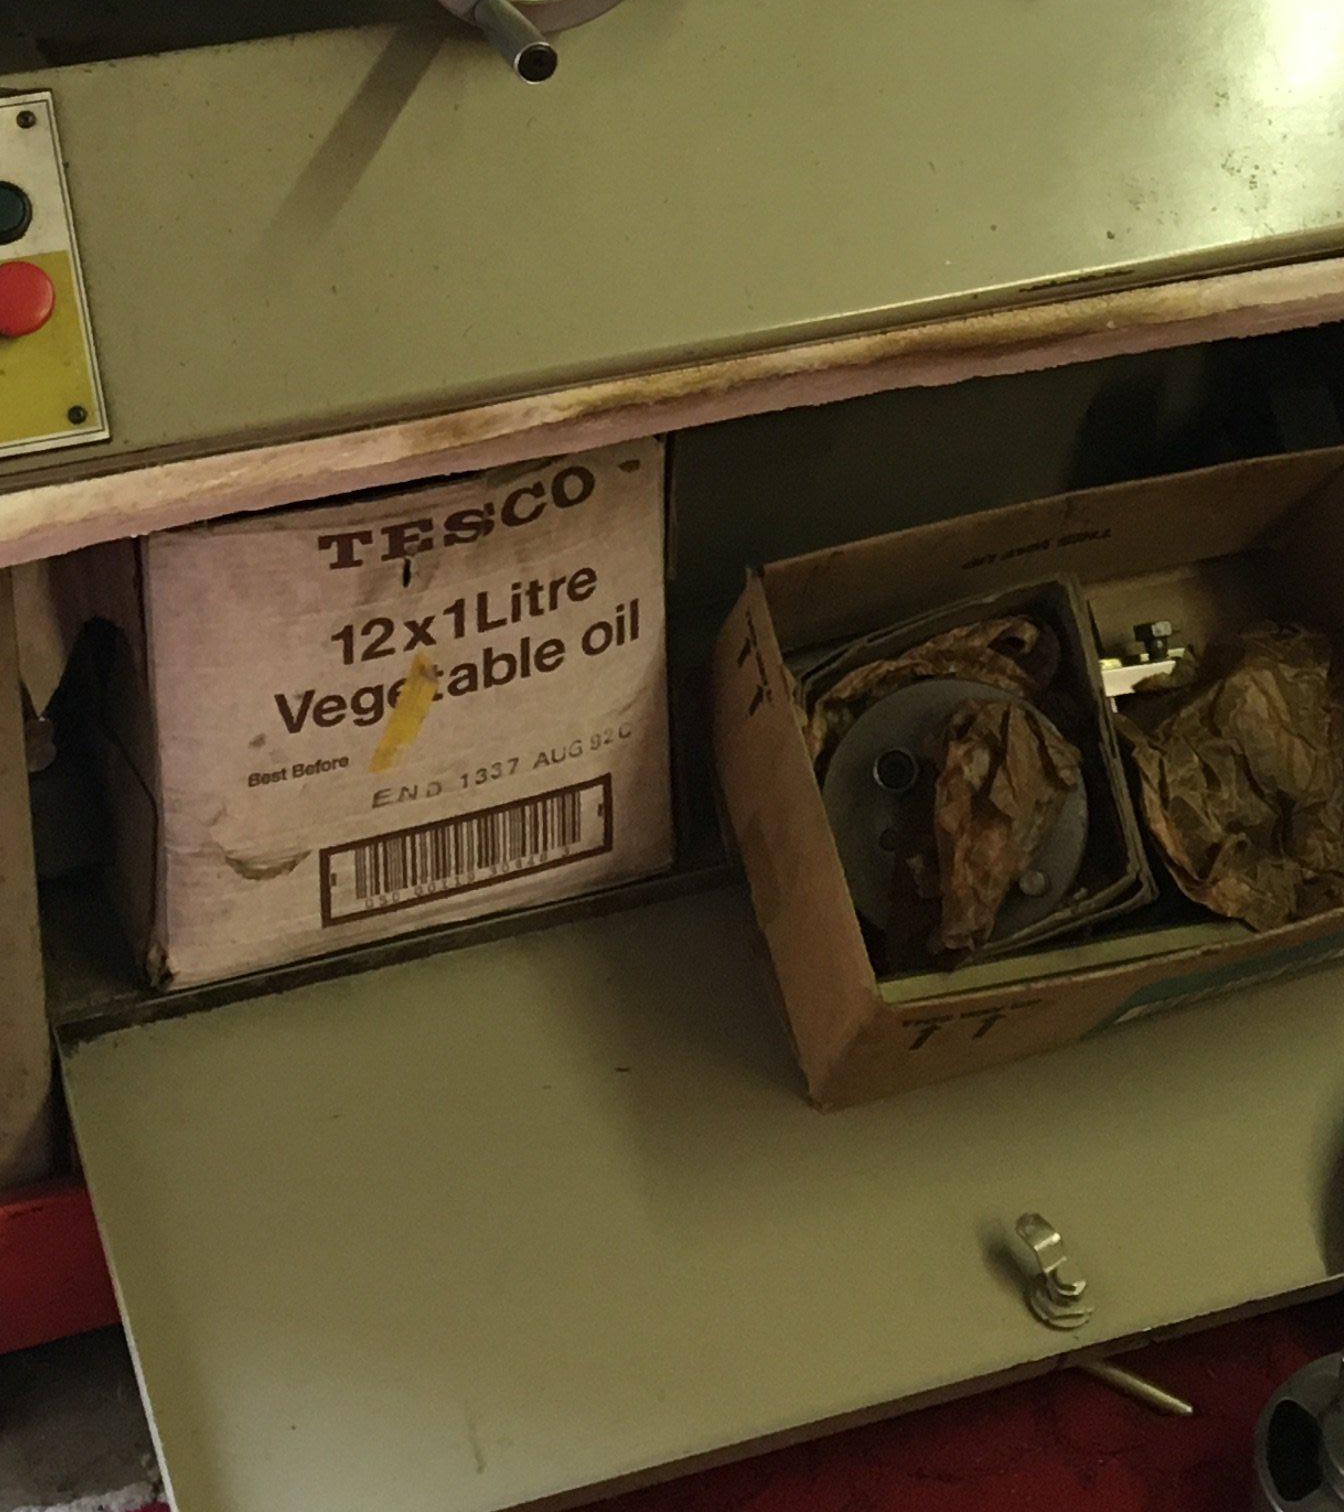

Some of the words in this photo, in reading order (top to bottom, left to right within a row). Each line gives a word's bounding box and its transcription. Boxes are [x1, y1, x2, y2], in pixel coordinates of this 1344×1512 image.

[317, 466, 595, 570] TESCO
[581, 597, 640, 656] oil
[248, 768, 288, 787] Best
[292, 756, 350, 779] Before
[460, 757, 519, 789] 1337
